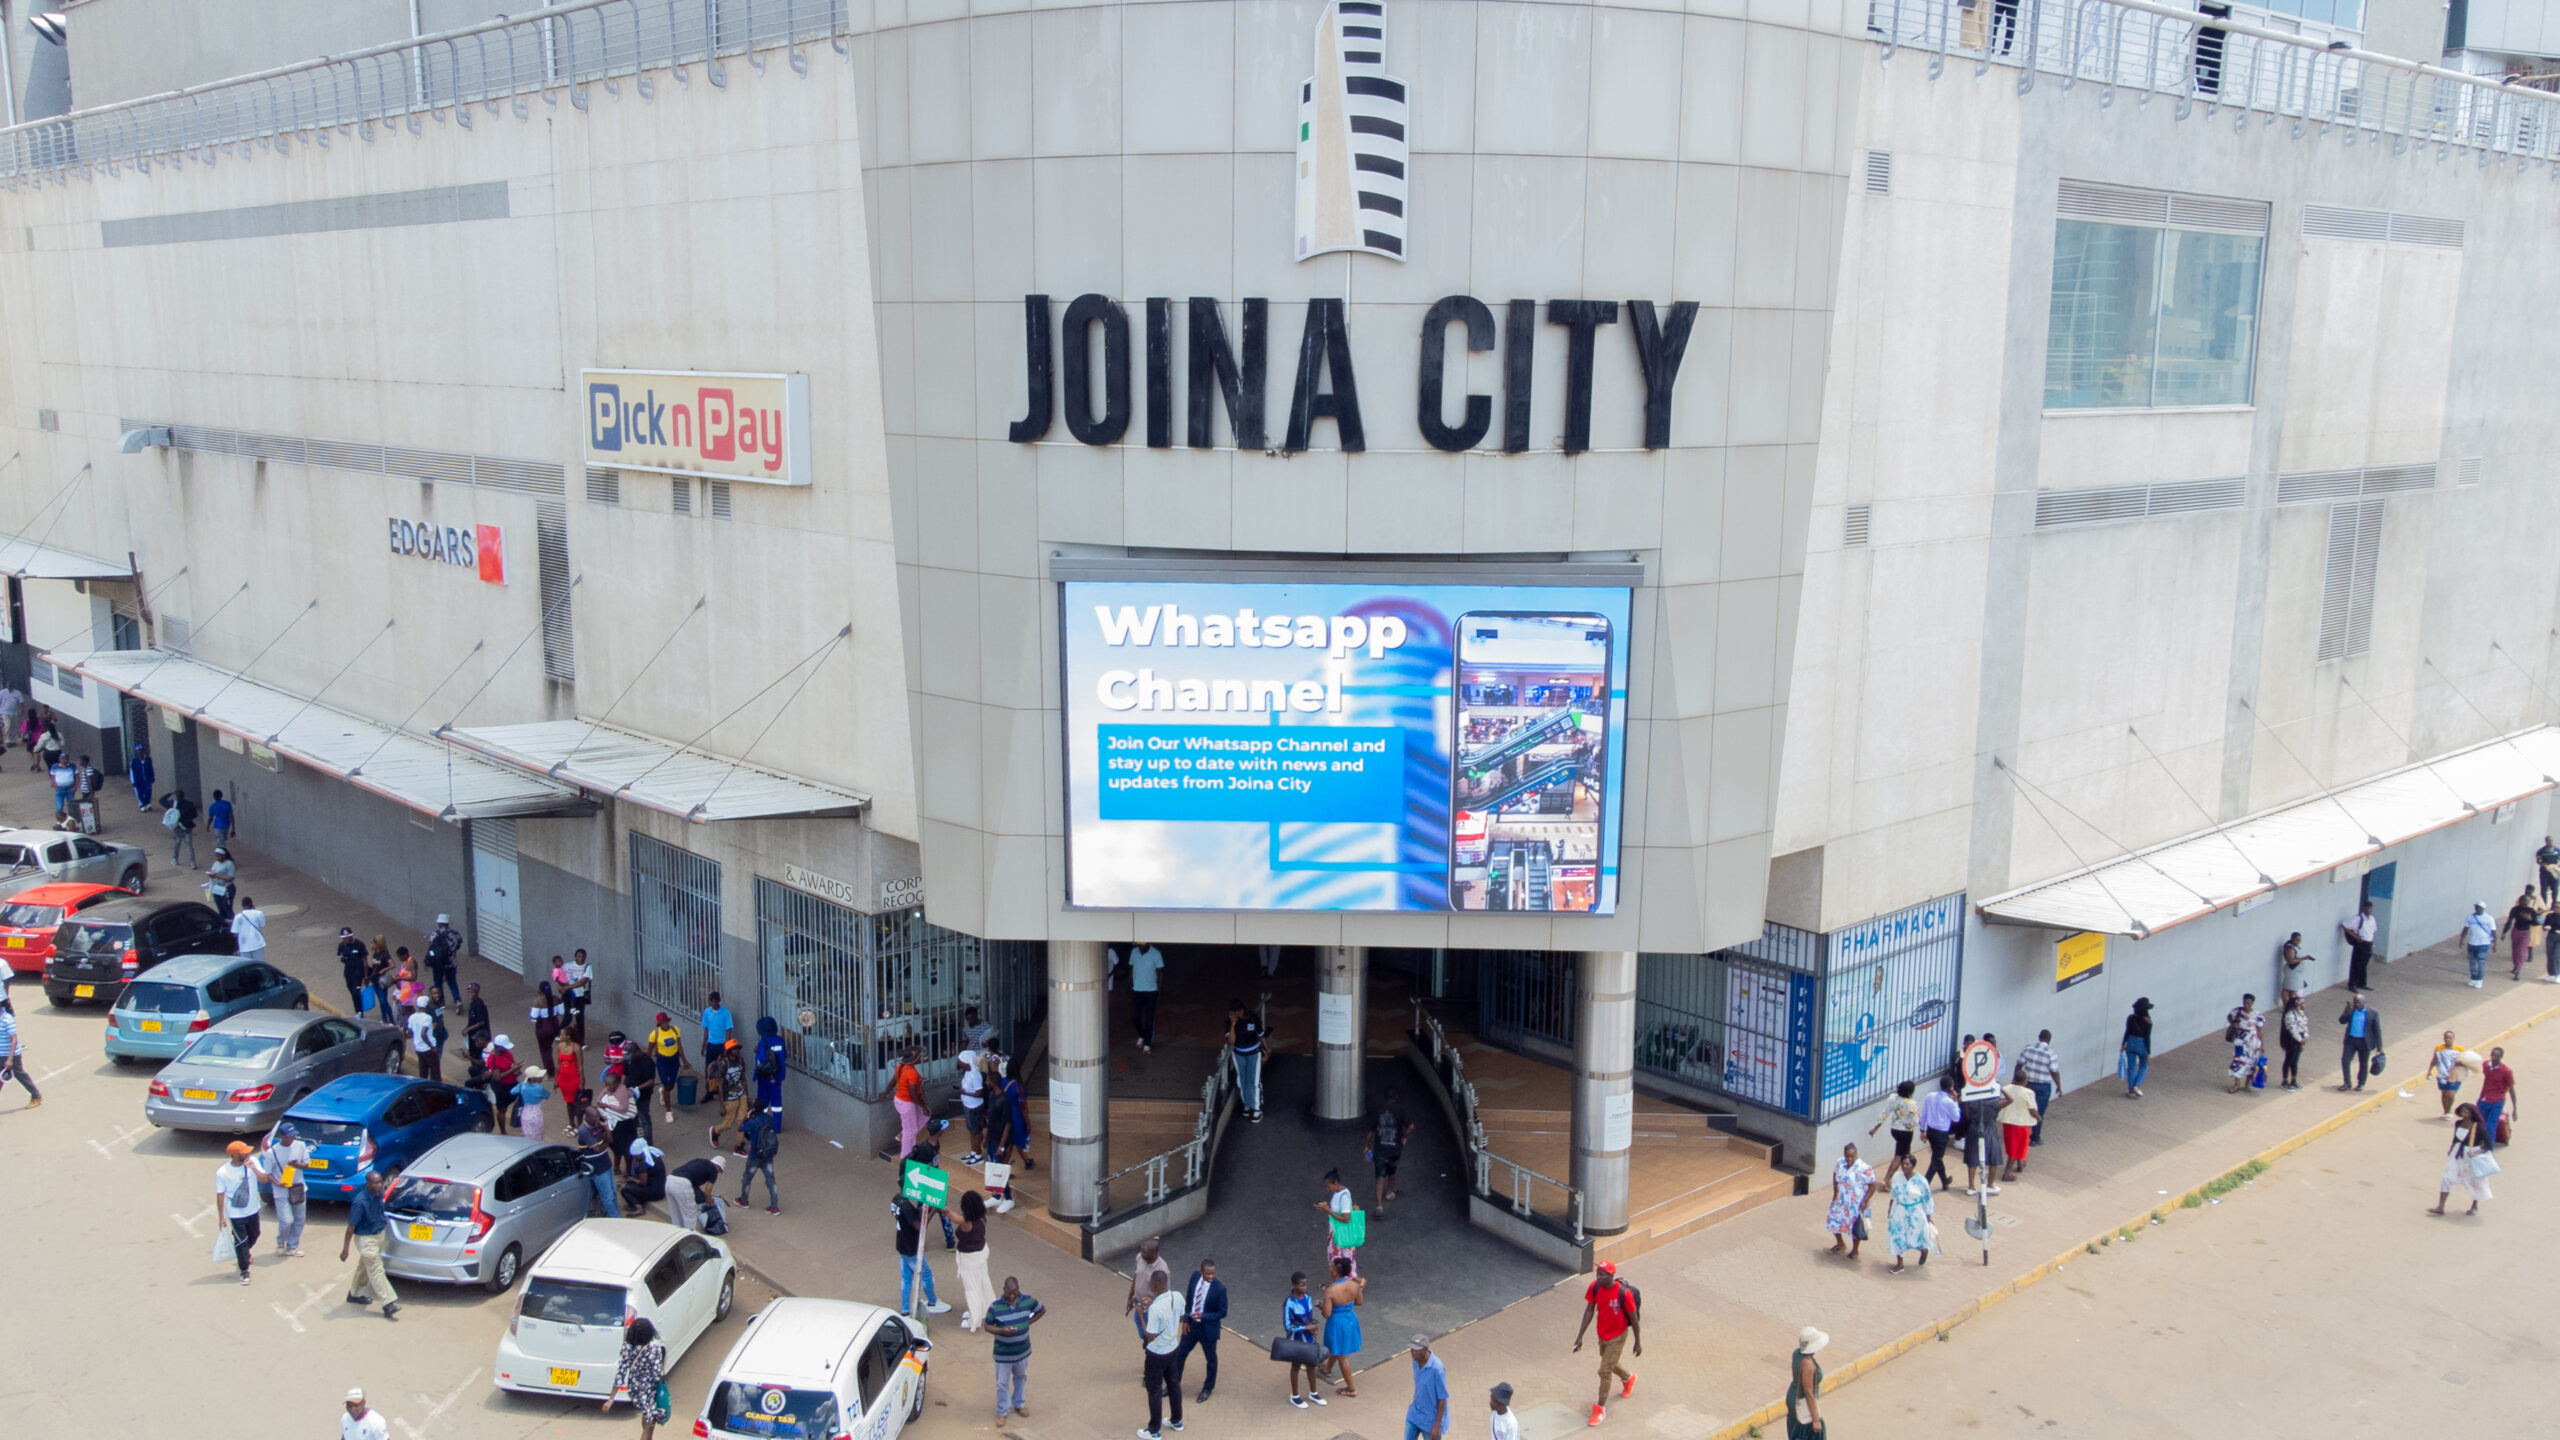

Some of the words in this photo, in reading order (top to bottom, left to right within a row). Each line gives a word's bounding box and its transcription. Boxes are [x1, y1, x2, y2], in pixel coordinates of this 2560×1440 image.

[1009, 293, 1366, 452] JOINA
[1418, 296, 1699, 453] CITY
[590, 385, 667, 448] Pick
[672, 404, 692, 447] n
[699, 388, 783, 471] Pay
[389, 517, 474, 568] EDGARS
[1095, 604, 1407, 659] Whatsapp
[1097, 669, 1342, 713] Channel
[1107, 736, 1144, 750] Join
[1147, 736, 1180, 750] Our
[1183, 737, 1273, 754] Whatsapp
[1277, 738, 1348, 752] Channel
[1352, 739, 1385, 752] and
[1108, 757, 1143, 772] stay
[1147, 759, 1170, 772] up
[1174, 757, 1192, 769] to
[1196, 756, 1235, 770] date
[1239, 757, 1278, 770] with
[1282, 760, 1327, 771] news
[1331, 758, 1364, 772] and
[1108, 775, 1178, 791] updates
[1183, 775, 1224, 789] from
[1228, 776, 1274, 790] Joina
[1277, 777, 1312, 793] City
[786, 866, 796, 882] &
[798, 870, 853, 903] AWARDS
[883, 890, 924, 909] RECOG
[1842, 905, 1948, 957] PHARMACY
[1794, 987, 1808, 1100] PHARMACY
[1974, 1051, 1988, 1077] P
[905, 1187, 922, 1199] ONE
[926, 1193, 942, 1205] WAY
[778, 1415, 796, 1424] TAXI
